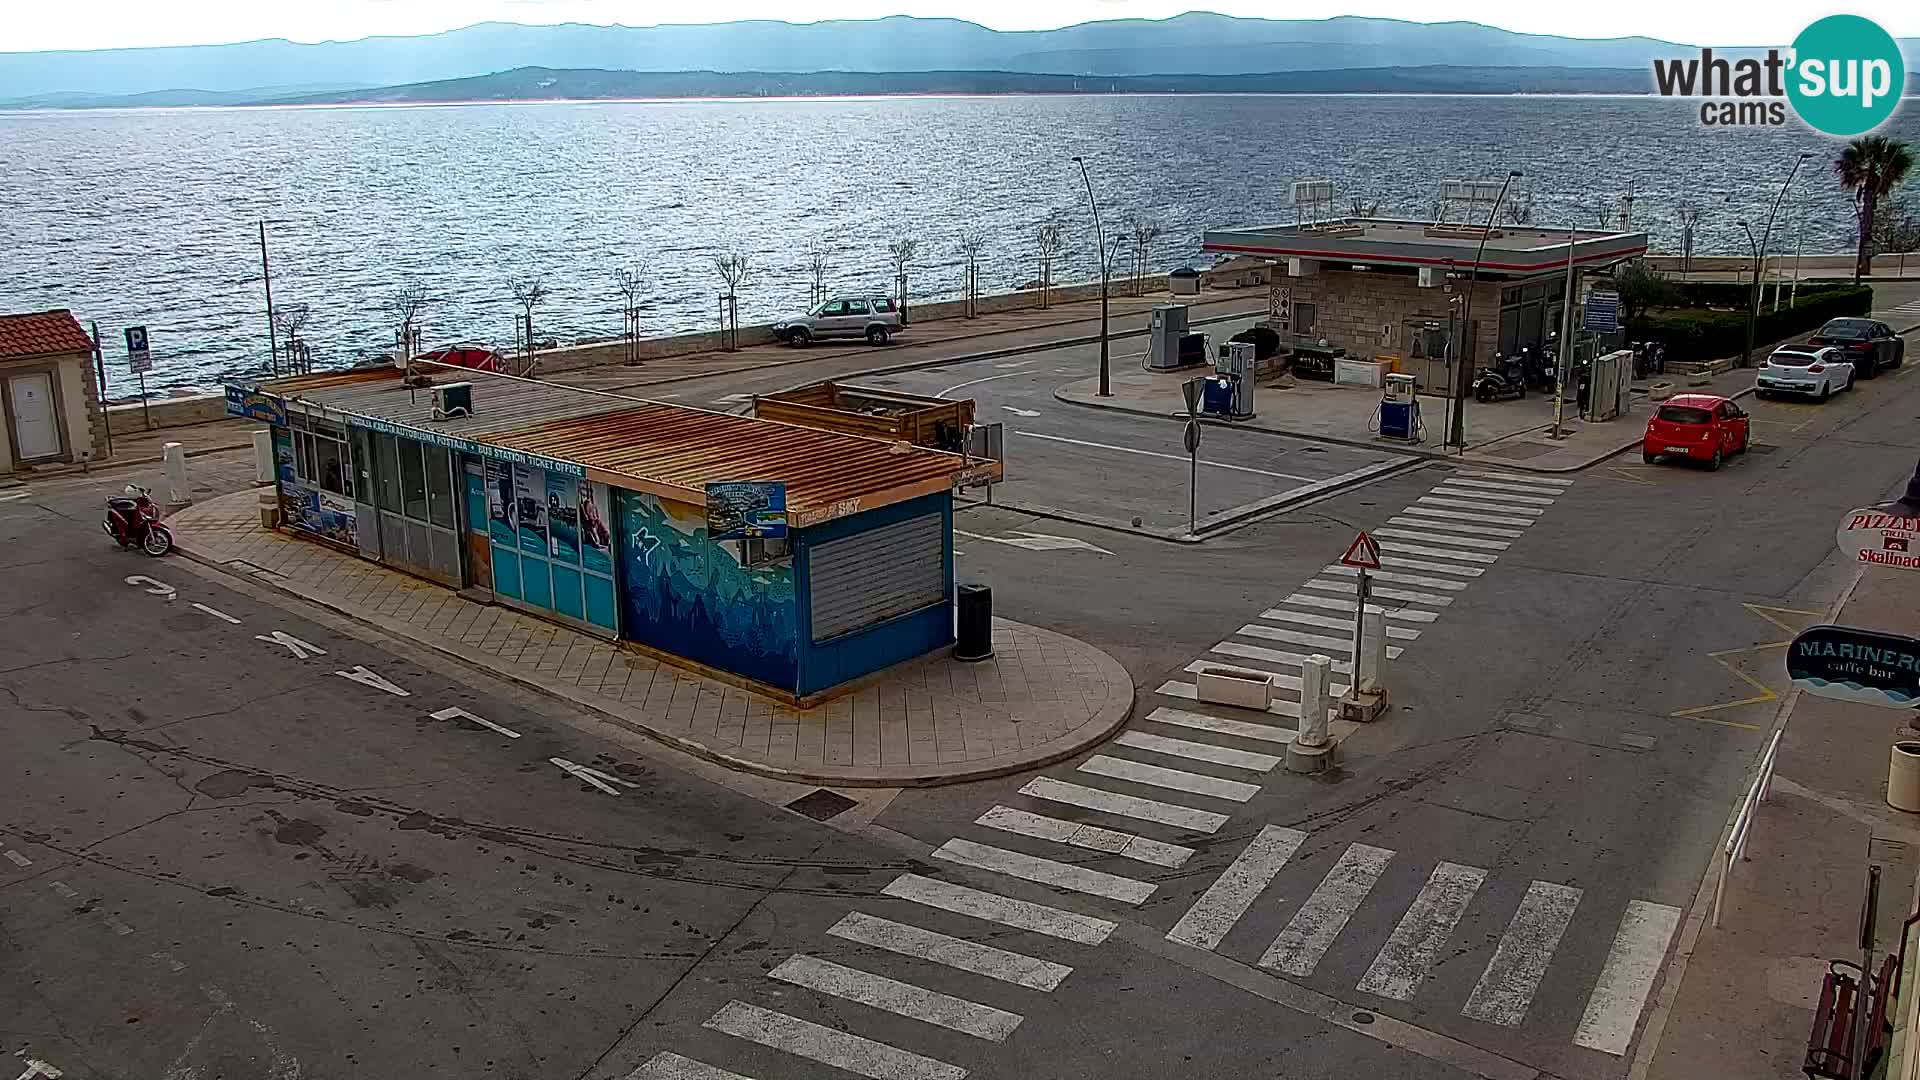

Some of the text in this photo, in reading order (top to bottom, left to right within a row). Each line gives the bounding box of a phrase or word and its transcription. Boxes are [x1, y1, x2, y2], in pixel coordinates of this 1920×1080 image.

[478, 445, 493, 457] BUS
[494, 448, 526, 464] STATION
[528, 455, 554, 471] TICKET
[555, 461, 582, 477] OFFICE
[1848, 513, 1920, 533] PIZZE
[1869, 664, 1896, 679] bar
